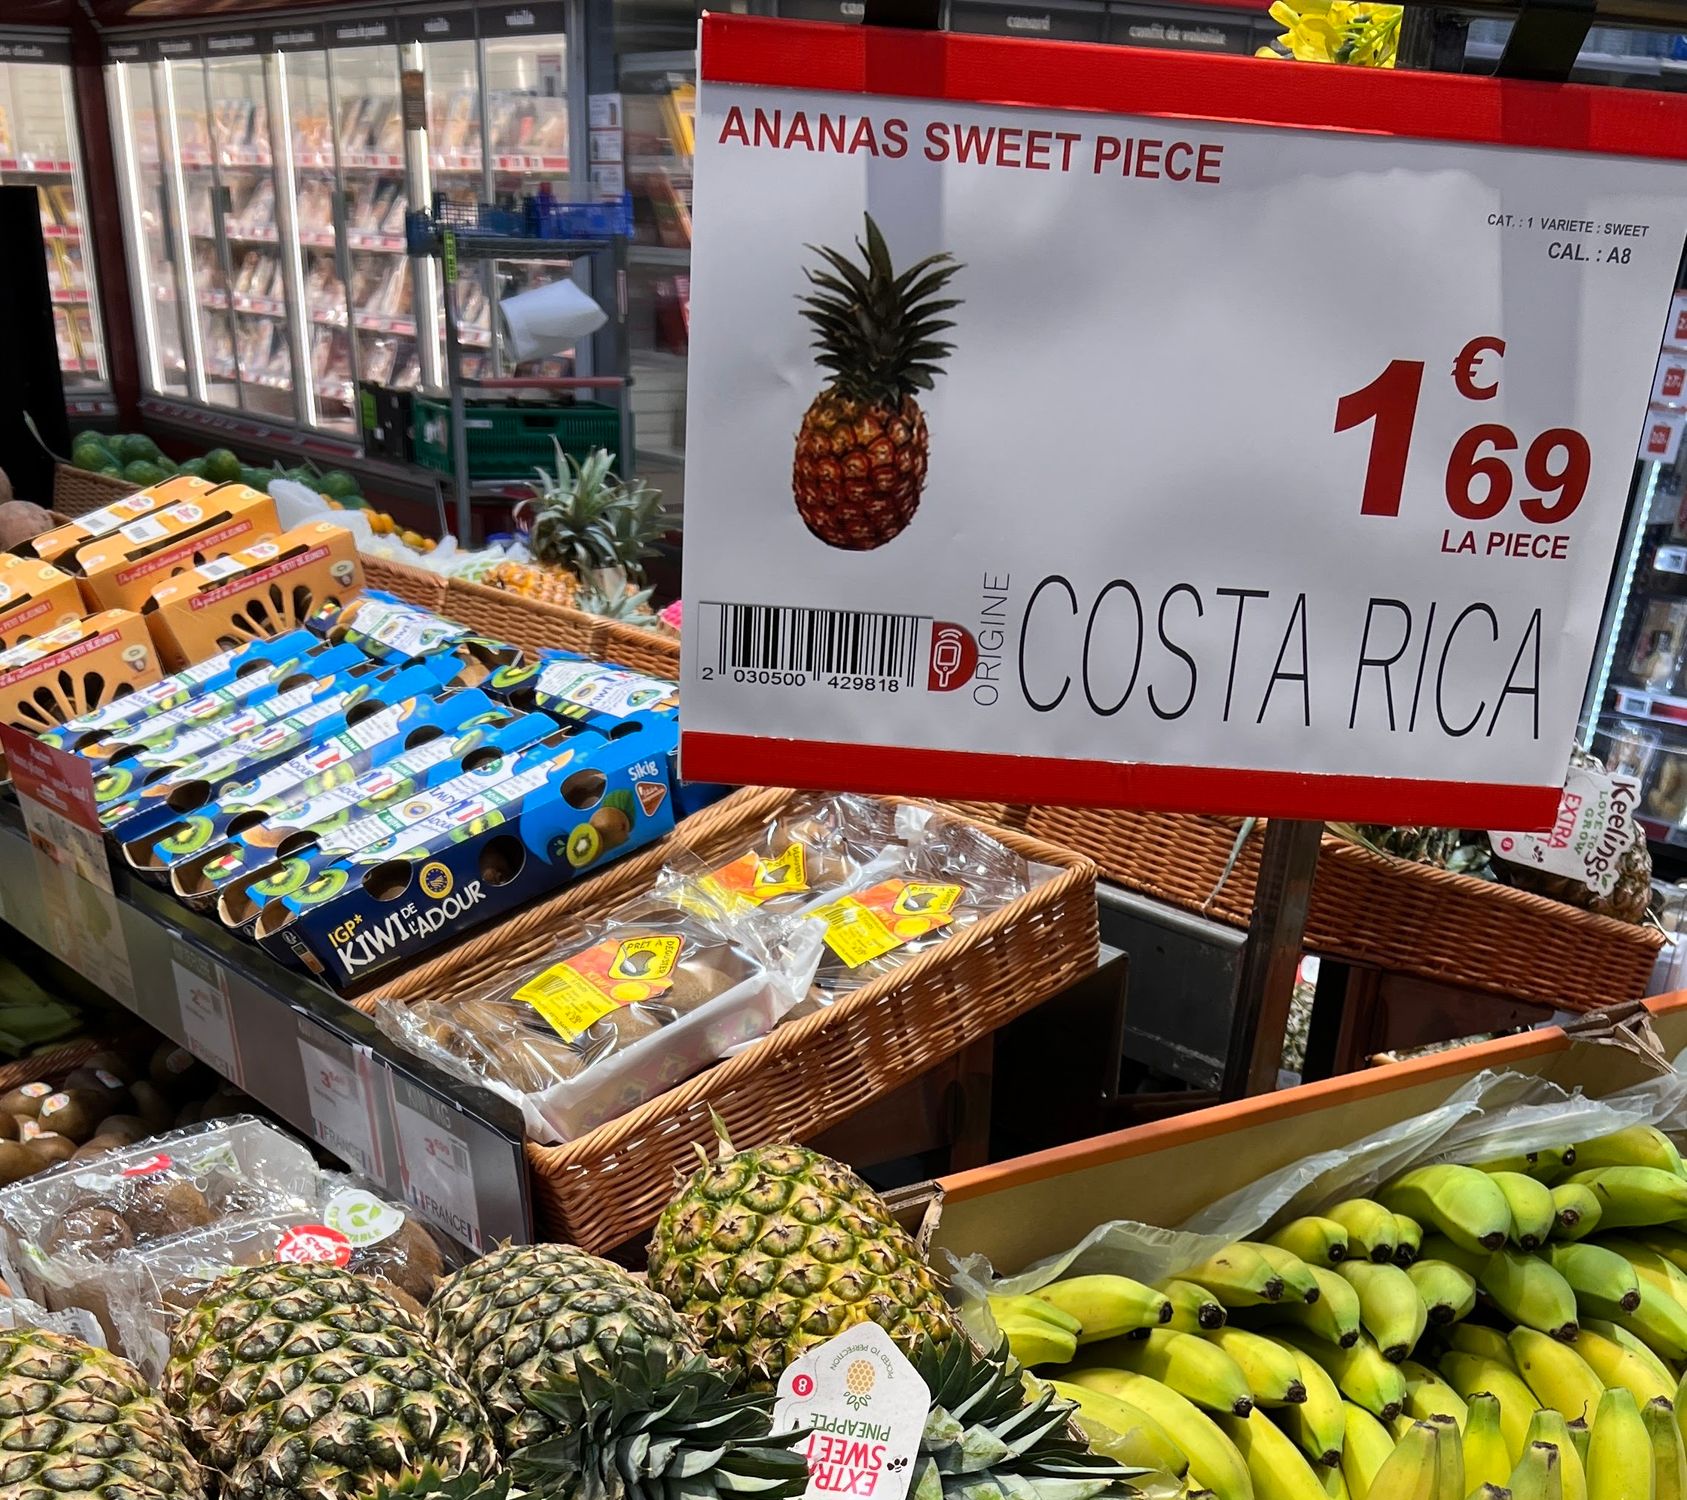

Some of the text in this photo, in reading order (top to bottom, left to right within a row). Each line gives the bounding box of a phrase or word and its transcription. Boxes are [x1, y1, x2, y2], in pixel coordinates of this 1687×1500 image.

[718, 105, 1224, 184] ANANAS SWEET PIECE
[1540, 217, 1594, 233] VARIETE
[1603, 222, 1650, 238] SWEET
[1547, 241, 1590, 261] CAL.
[1606, 246, 1632, 265] A8
[1450, 336, 1506, 400] €
[1445, 423, 1591, 524] 69
[1441, 529, 1570, 560] LA PIECE
[973, 571, 1010, 706] ORIGINE
[1018, 574, 1542, 740] COSTA RICA
[702, 667, 900, 693] 2 030500 429818
[1551, 792, 1582, 849] EXTRA
[1583, 780, 1635, 881] Keelings
[337, 912, 410, 974] KIWI
[401, 902, 418, 920] DE
[425, 1194, 467, 1238] FRANCE
[806, 1434, 887, 1470] SWEET
[810, 1413, 892, 1442] PINEAPPLE
